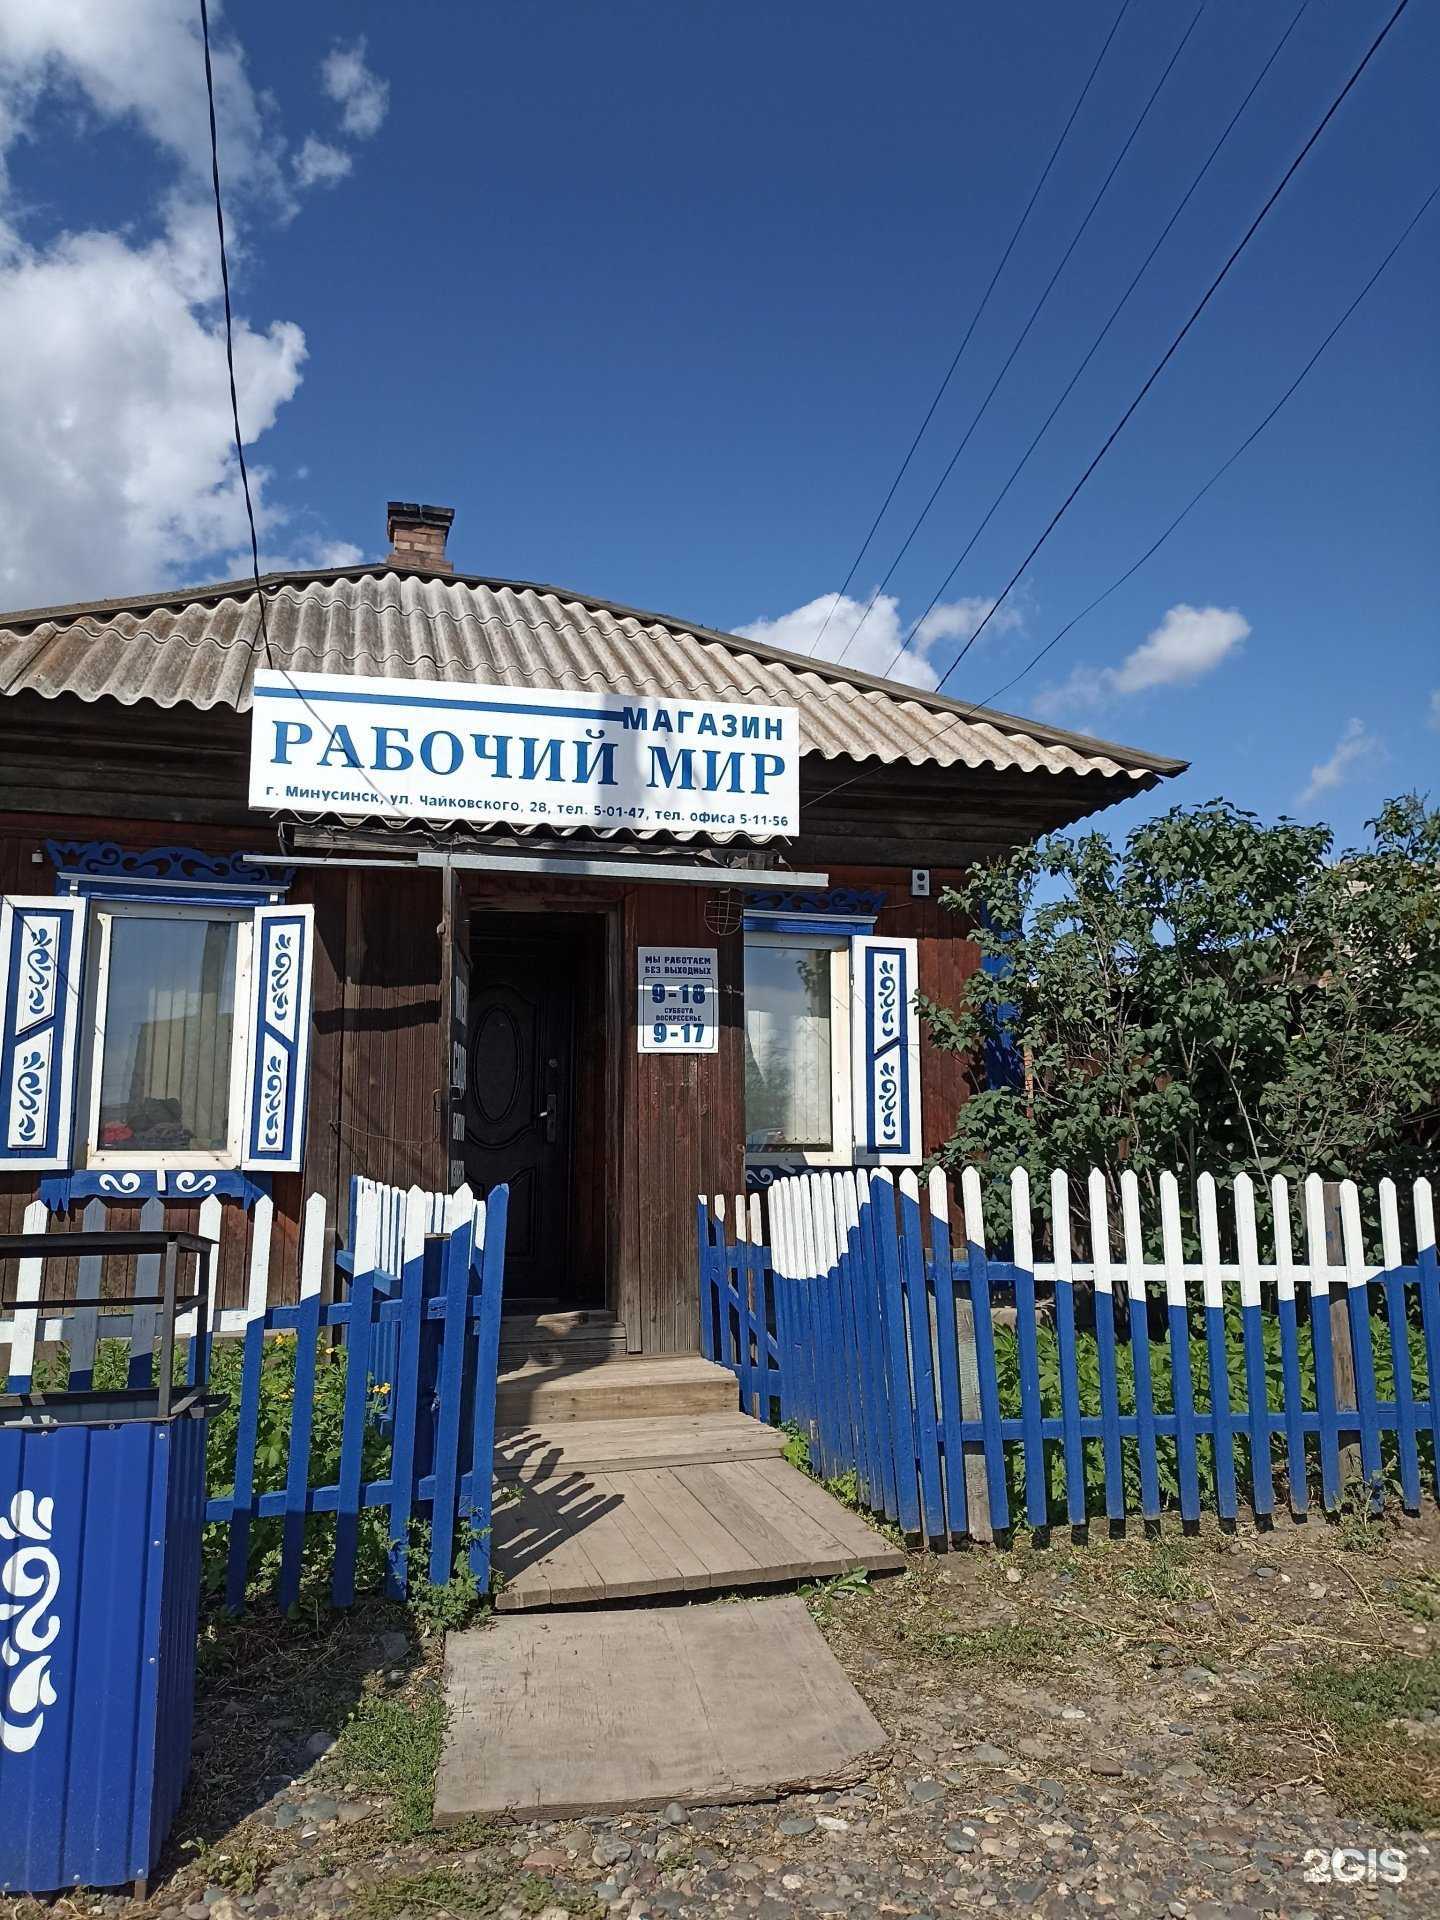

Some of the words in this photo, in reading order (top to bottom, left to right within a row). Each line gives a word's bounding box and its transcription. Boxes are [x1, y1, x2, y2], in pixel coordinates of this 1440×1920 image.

[623, 706, 782, 741] МАГАЗИН
[270, 720, 619, 786] РАБОЧИЙ
[646, 745, 786, 795] МИР
[265, 785, 279, 797] г.
[285, 785, 384, 804] Минусинск,
[390, 792, 413, 806] ул.
[419, 794, 524, 813] Чайковского,
[529, 801, 551, 815] 28,
[557, 803, 588, 816] тел.
[594, 805, 649, 821] 5-01-47,
[655, 809, 685, 822] тел.
[690, 810, 735, 825] офиса
[740, 813, 788, 827] 5-11-56
[645, 956, 661, 964] МЫ
[664, 956, 711, 965] РАБОТАЕМ
[645, 966, 661, 974] БЕЗ
[664, 966, 711, 976] ВЫХОДНЫХ
[651, 983, 706, 1004] 9-18
[655, 1014, 702, 1022] ВОСКРЕСЕНЬЕ
[653, 1022, 705, 1043] 9-17
